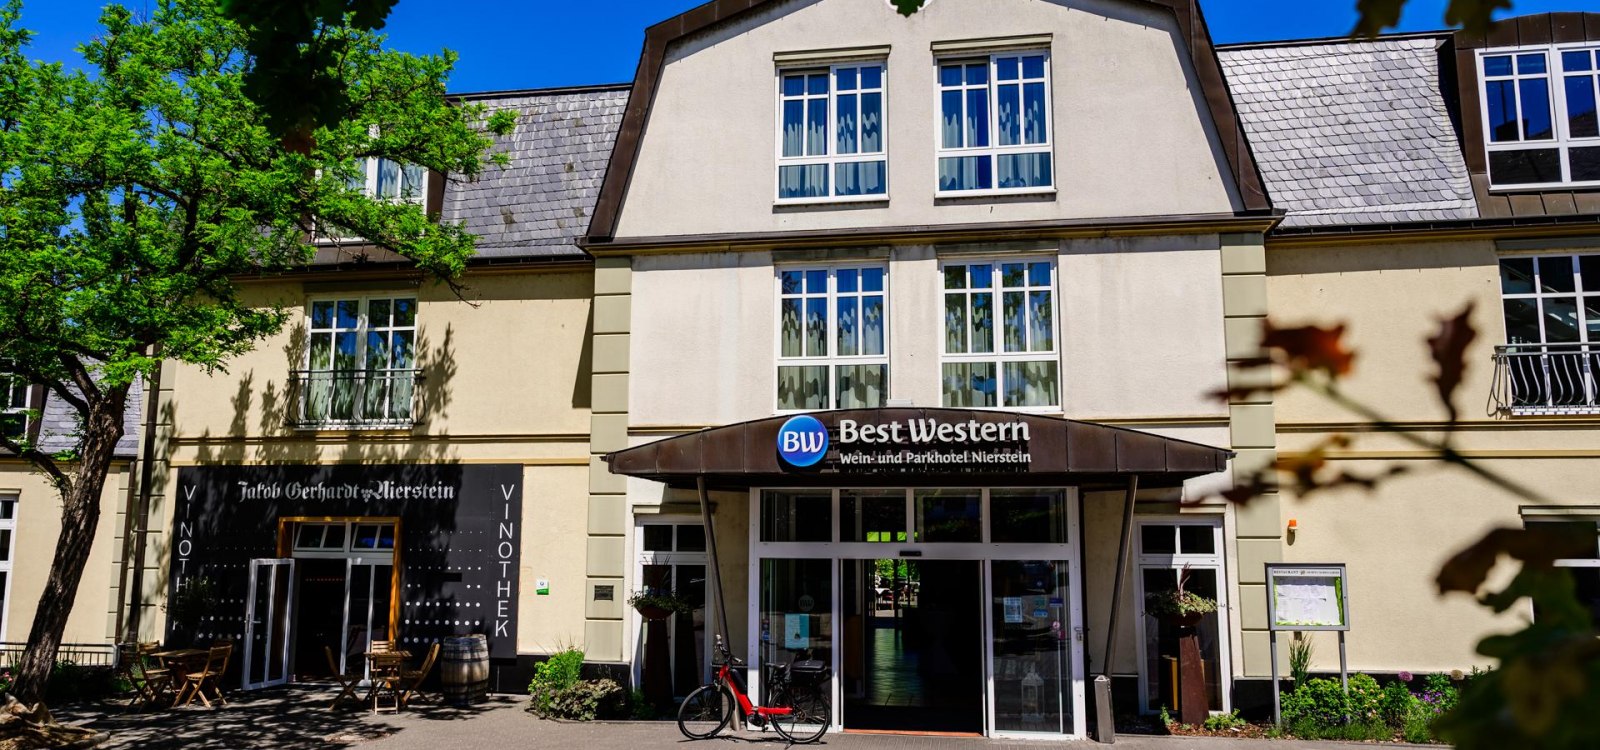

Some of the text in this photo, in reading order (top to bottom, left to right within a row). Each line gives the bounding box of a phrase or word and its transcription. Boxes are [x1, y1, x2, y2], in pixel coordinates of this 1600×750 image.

[782, 430, 825, 454] BW
[839, 417, 1031, 444] Best Western
[839, 451, 1032, 465] Wein- und Parkhotel Nierstein
[238, 480, 455, 502] Jakob Gerhardt Nierstein
[495, 484, 515, 638] VINOTHEK
